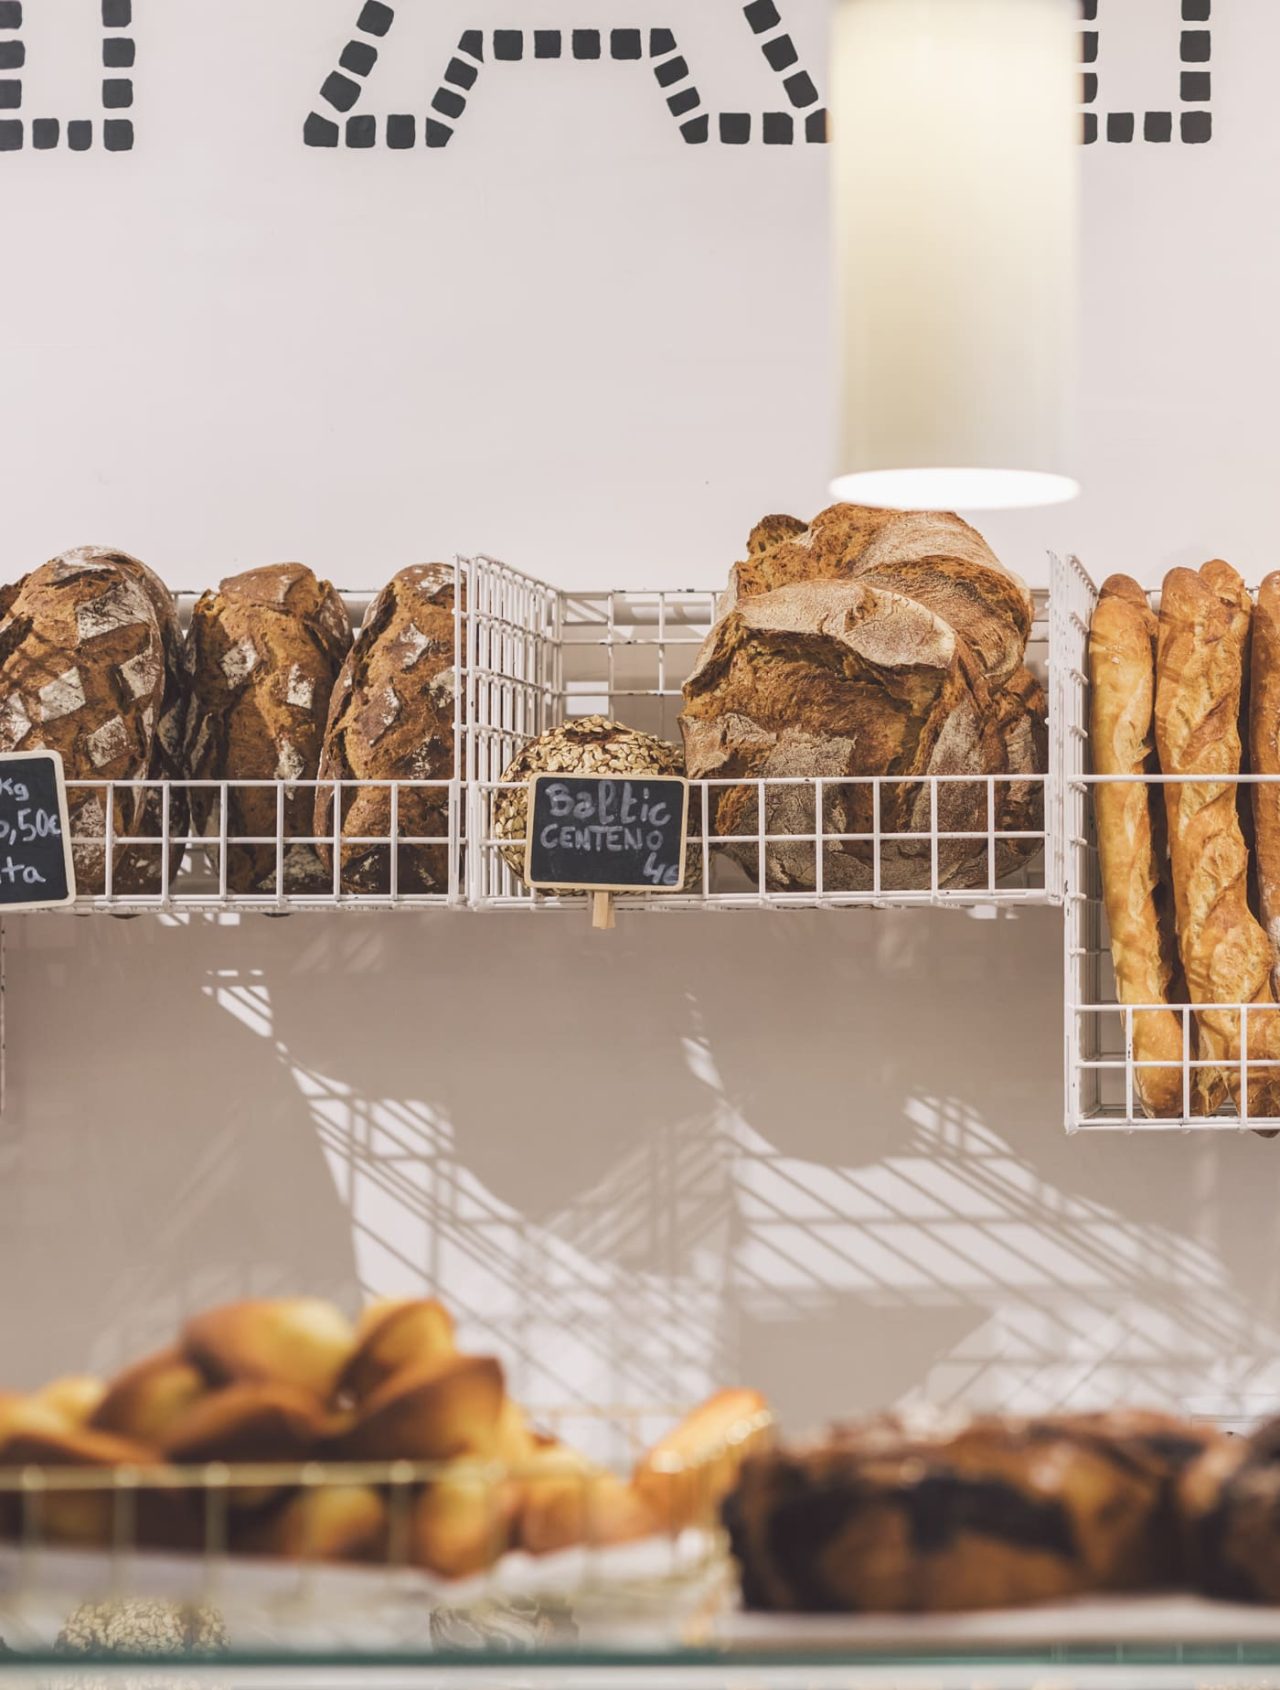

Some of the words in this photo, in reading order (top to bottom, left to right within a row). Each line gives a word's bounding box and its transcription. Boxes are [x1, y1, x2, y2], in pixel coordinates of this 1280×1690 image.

[545, 780, 671, 825] Baltic
[540, 823, 664, 851] CENTENO
[0, 855, 47, 884] ta
